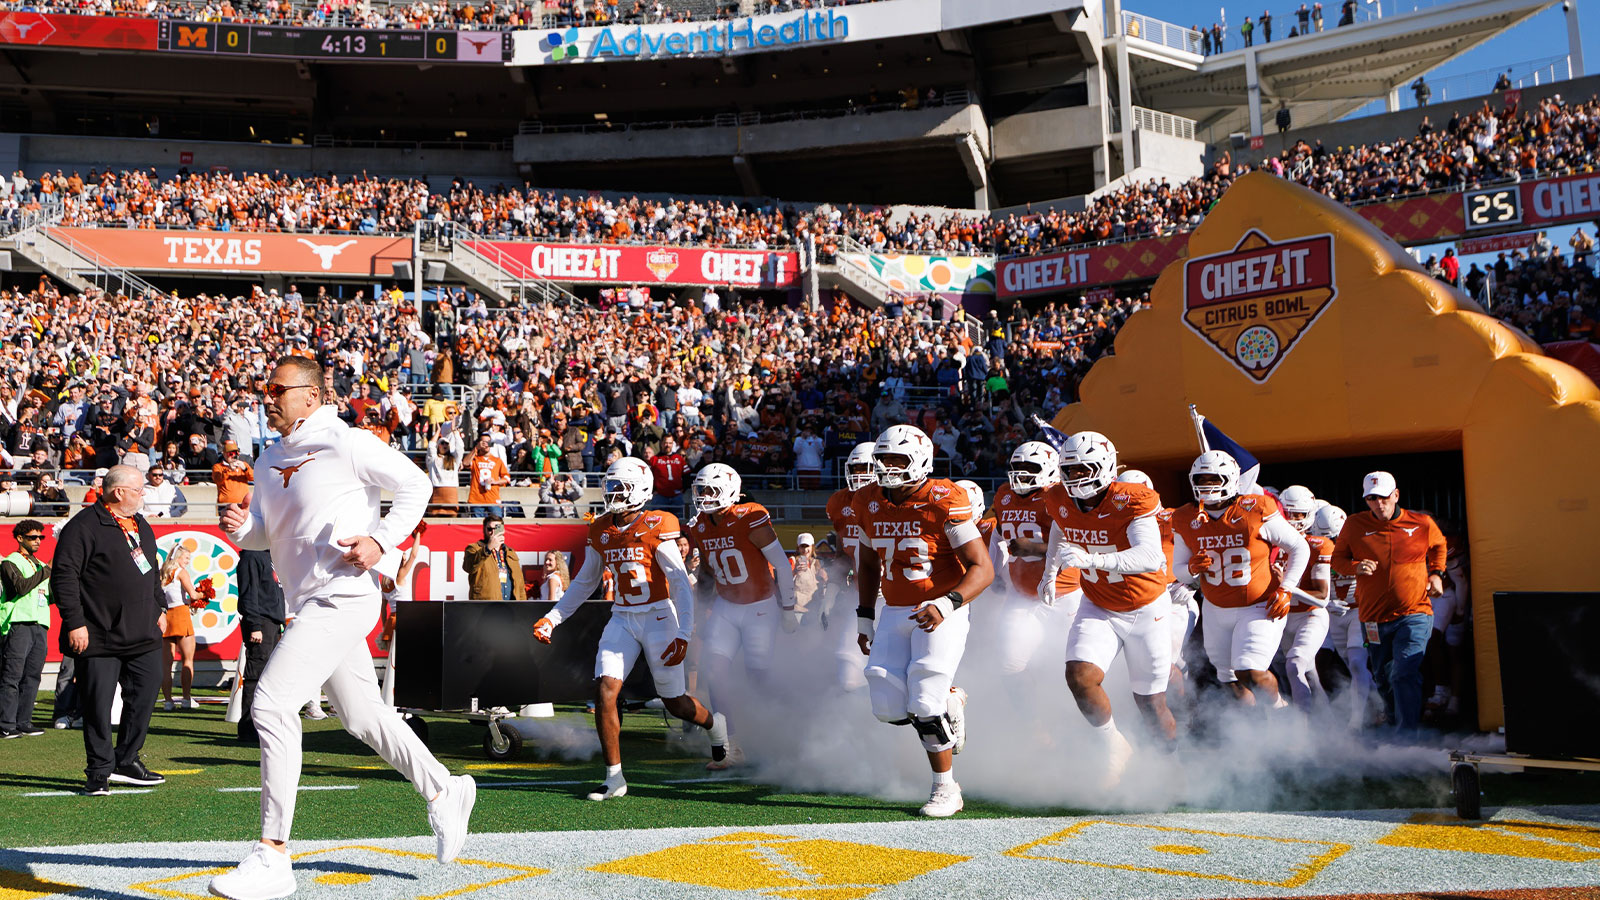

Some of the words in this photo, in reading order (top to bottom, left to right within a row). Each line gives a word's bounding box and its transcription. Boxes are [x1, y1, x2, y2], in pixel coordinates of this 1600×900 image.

[178, 26, 208, 48] M
[227, 31, 239, 47] 0
[592, 8, 849, 57] AdventHealth
[321, 34, 366, 53] 4:13
[379, 42, 386, 56] 1
[436, 38, 447, 54] 0
[1472, 191, 1514, 224] 25
[163, 236, 262, 265] TEXAS
[1205, 304, 1258, 325] CITRUS
[1265, 296, 1310, 317] BOWL
[666, 464, 675, 481] 1
[1001, 509, 1037, 523] TEXAS
[873, 521, 921, 537] TEXAS
[1064, 527, 1109, 544] TEXAS
[702, 536, 735, 550] TEXAS
[1196, 533, 1244, 550] TEXAS
[603, 547, 644, 562] TEXAS
[870, 537, 934, 581] 73
[1200, 547, 1251, 587] 98
[608, 562, 651, 605] 13
